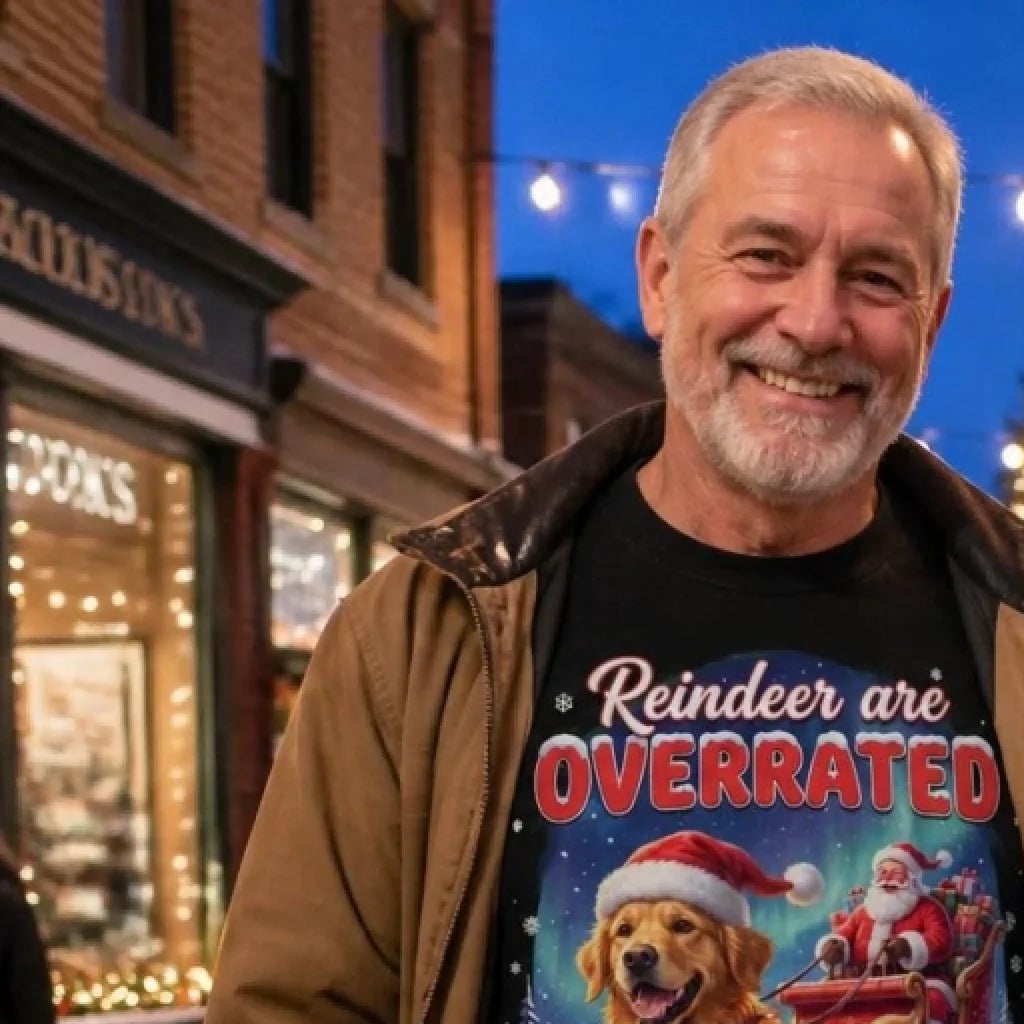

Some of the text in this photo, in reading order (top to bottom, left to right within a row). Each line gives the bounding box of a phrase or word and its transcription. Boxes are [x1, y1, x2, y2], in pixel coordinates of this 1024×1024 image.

[587, 656, 951, 735] Reindeer are
[534, 731, 1001, 823] OVERRATED
